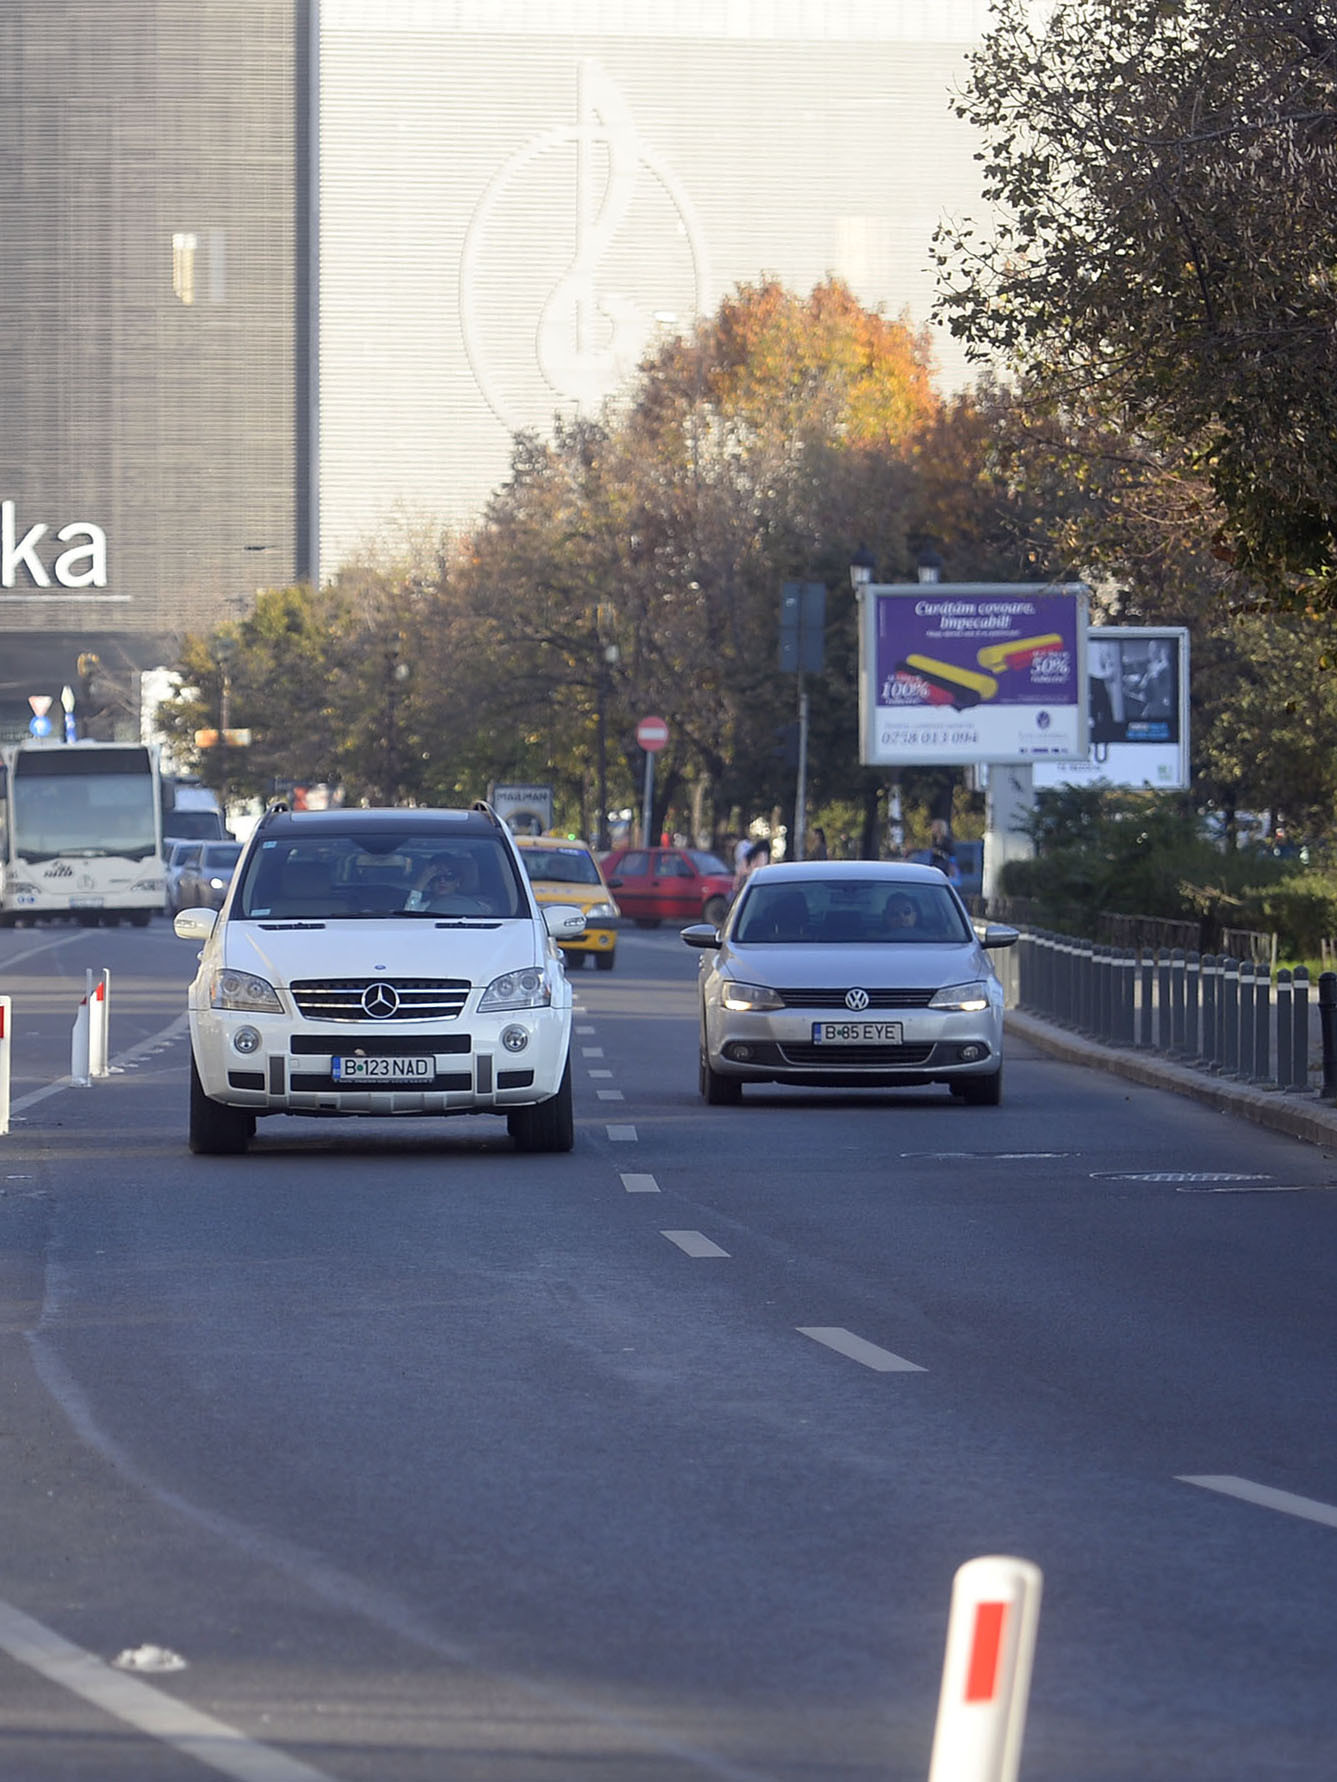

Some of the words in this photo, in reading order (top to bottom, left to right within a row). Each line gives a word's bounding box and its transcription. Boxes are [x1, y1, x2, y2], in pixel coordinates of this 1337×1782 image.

[882, 681, 931, 699] 100%
[842, 1025, 859, 1040] 85
[863, 1025, 896, 1040] EYE
[345, 1059, 357, 1076] B
[363, 1059, 390, 1076] 123
[392, 1059, 428, 1076] NAD
